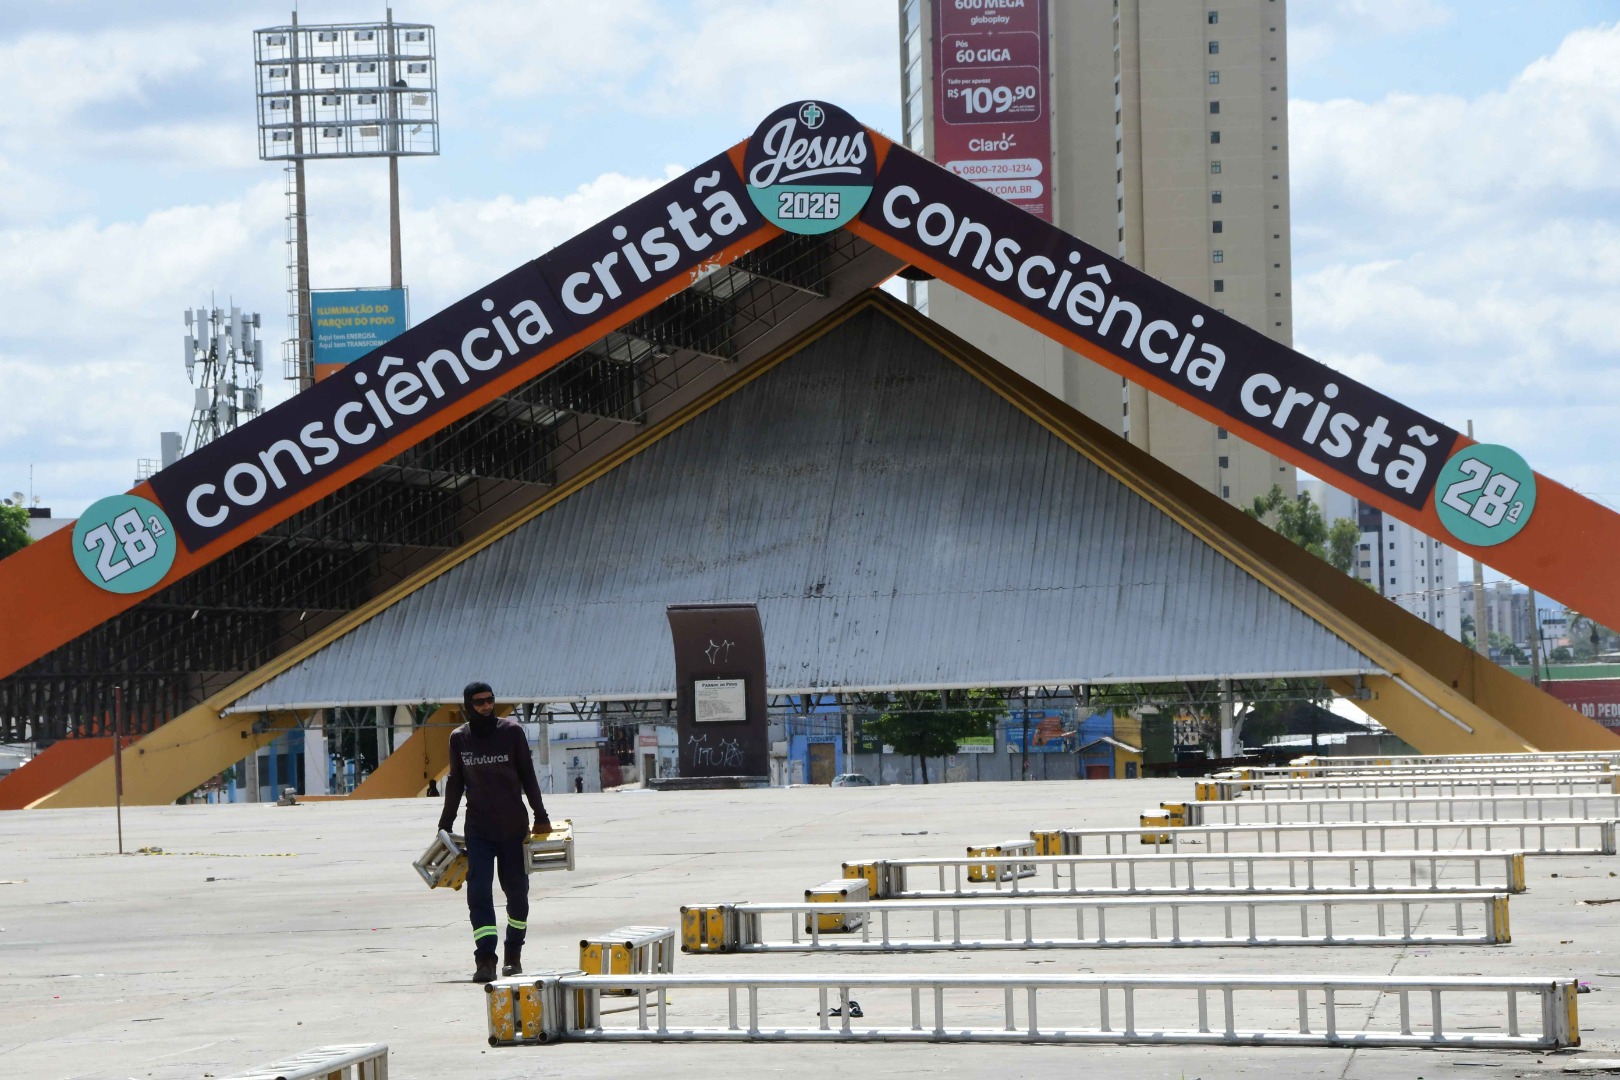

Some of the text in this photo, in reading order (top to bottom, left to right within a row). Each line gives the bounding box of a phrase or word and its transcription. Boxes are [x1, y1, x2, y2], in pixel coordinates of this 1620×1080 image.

[955, 0, 1025, 10] 600 MEGA
[970, 15, 1010, 25] globoplay
[955, 40, 968, 48] Pós
[955, 48, 1011, 63] 60 GIGA
[947, 85, 1036, 114] R$ 109,90
[968, 135, 1011, 152] Claro
[749, 117, 868, 189] Jesus
[963, 164, 1032, 174] 0800-720-1234
[777, 191, 841, 219] 2026
[317, 304, 389, 315] ILUMINAÇÃO DO
[317, 316, 395, 328] PARQUE DO POVO
[318, 334, 333, 342] Aqui
[882, 184, 1439, 495] consciência cristã
[185, 170, 748, 528] consciência cristã
[319, 342, 333, 350] Aqui
